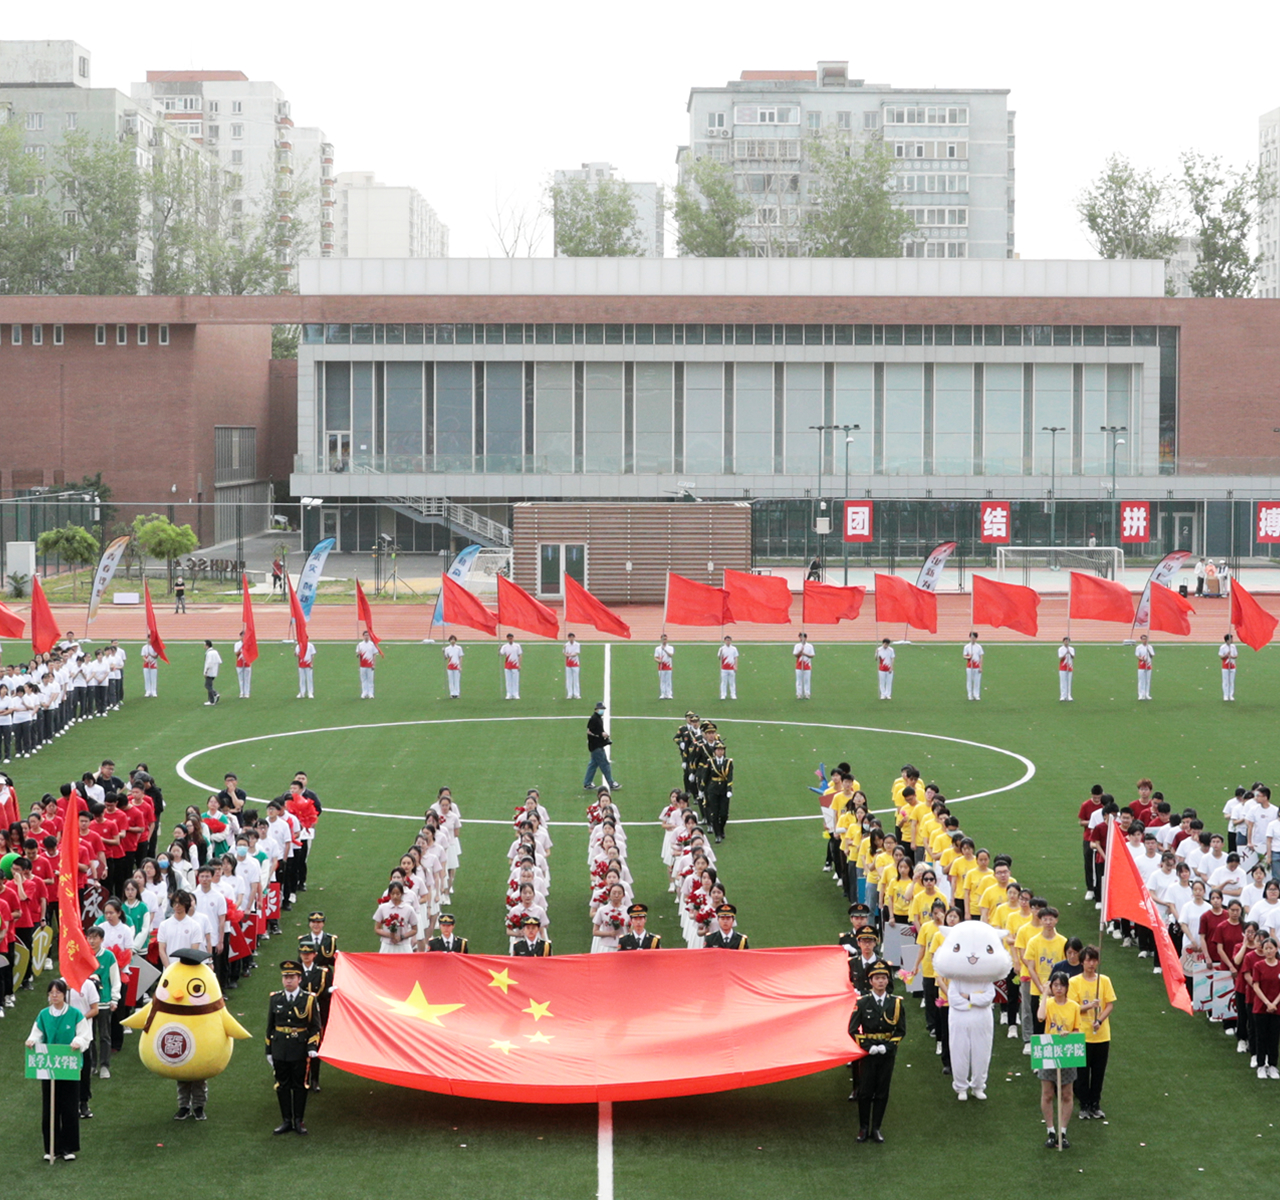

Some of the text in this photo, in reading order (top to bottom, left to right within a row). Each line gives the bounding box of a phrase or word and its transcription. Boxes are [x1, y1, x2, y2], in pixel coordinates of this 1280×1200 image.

[847, 507, 870, 536] 团
[983, 507, 1007, 537] 结
[1123, 507, 1147, 536] 拼
[28, 1053, 79, 1070] 医学人文学院
[1032, 1042, 1085, 1060] 基础医学院
